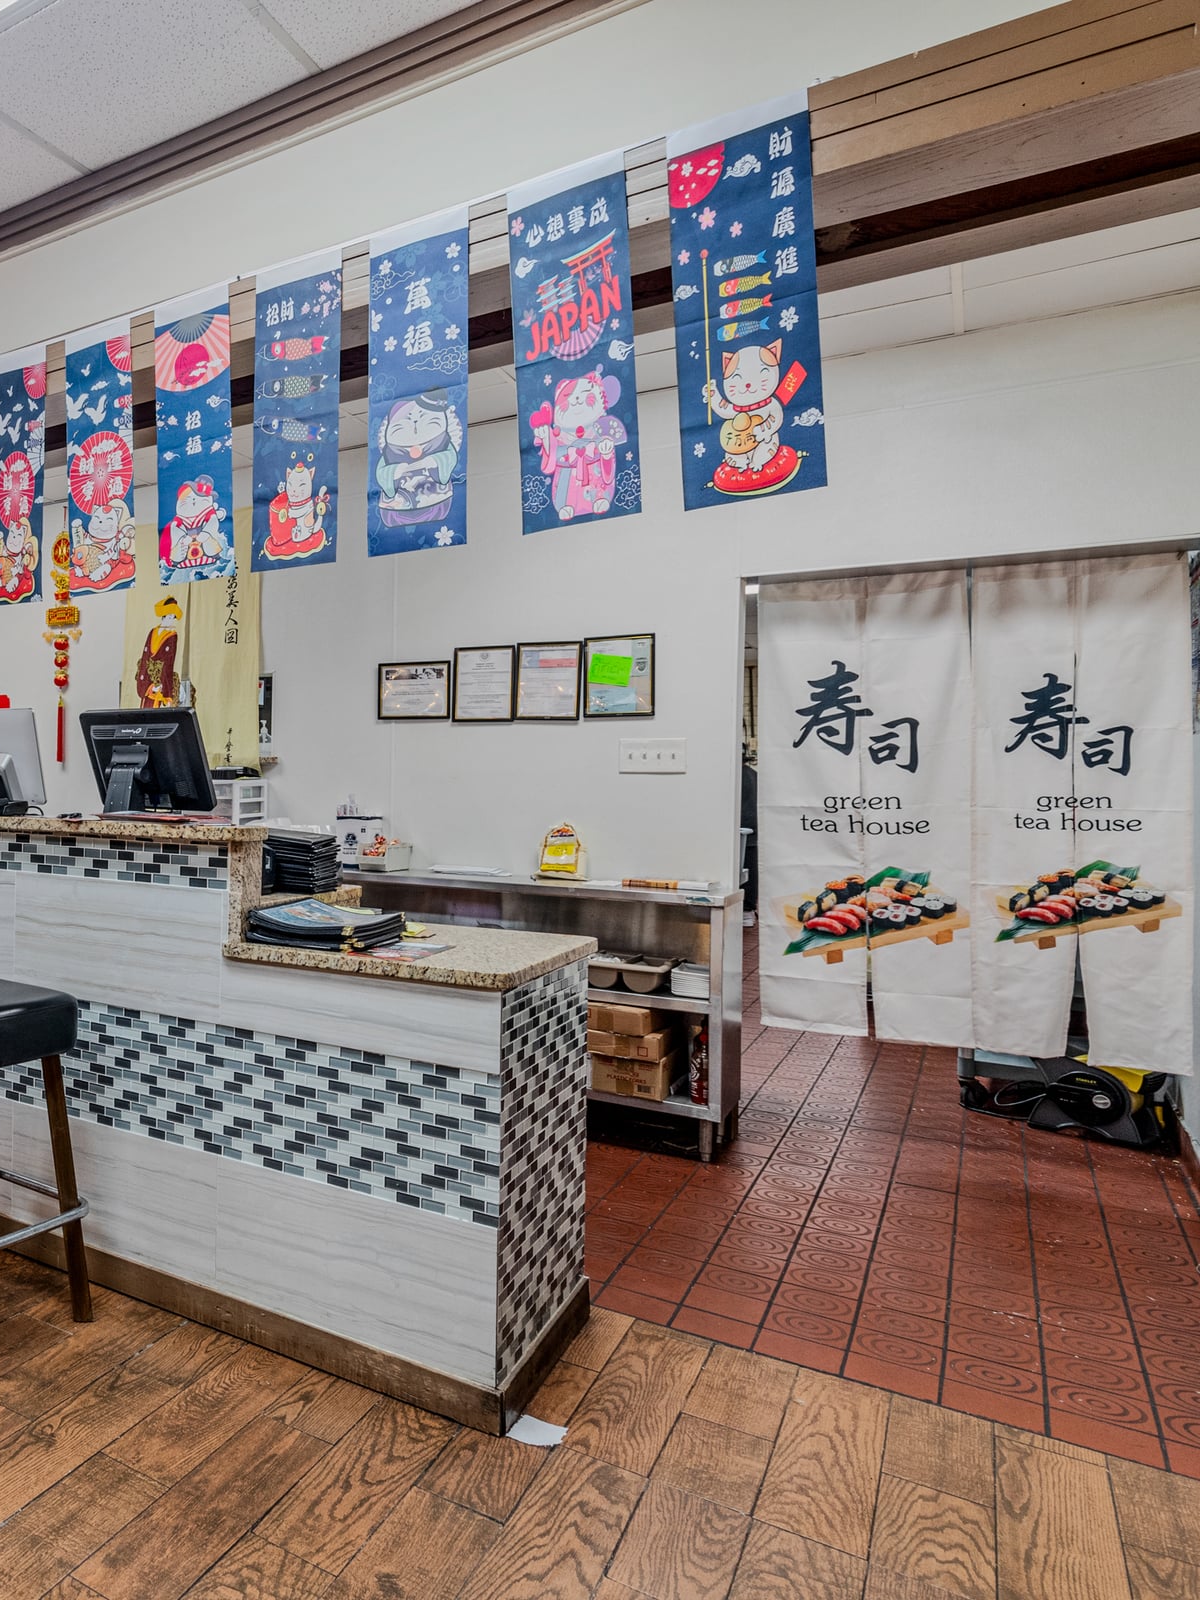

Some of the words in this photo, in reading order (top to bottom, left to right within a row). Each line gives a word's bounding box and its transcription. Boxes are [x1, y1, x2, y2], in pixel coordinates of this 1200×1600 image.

[525, 197, 609, 248] 心想事成
[769, 126, 799, 279] 財源廣進
[265, 297, 294, 328] 招財
[402, 277, 434, 356] 萬福
[526, 274, 622, 361] JAPAN
[184, 410, 202, 456] 招福
[792, 659, 920, 774] 寿司
[1004, 672, 1135, 777] 寿司
[800, 814, 839, 833] tea
[848, 814, 931, 836] house
[822, 794, 902, 812] green
[1013, 813, 1050, 831] tea
[1059, 813, 1143, 832] house
[1035, 793, 1113, 812] green
